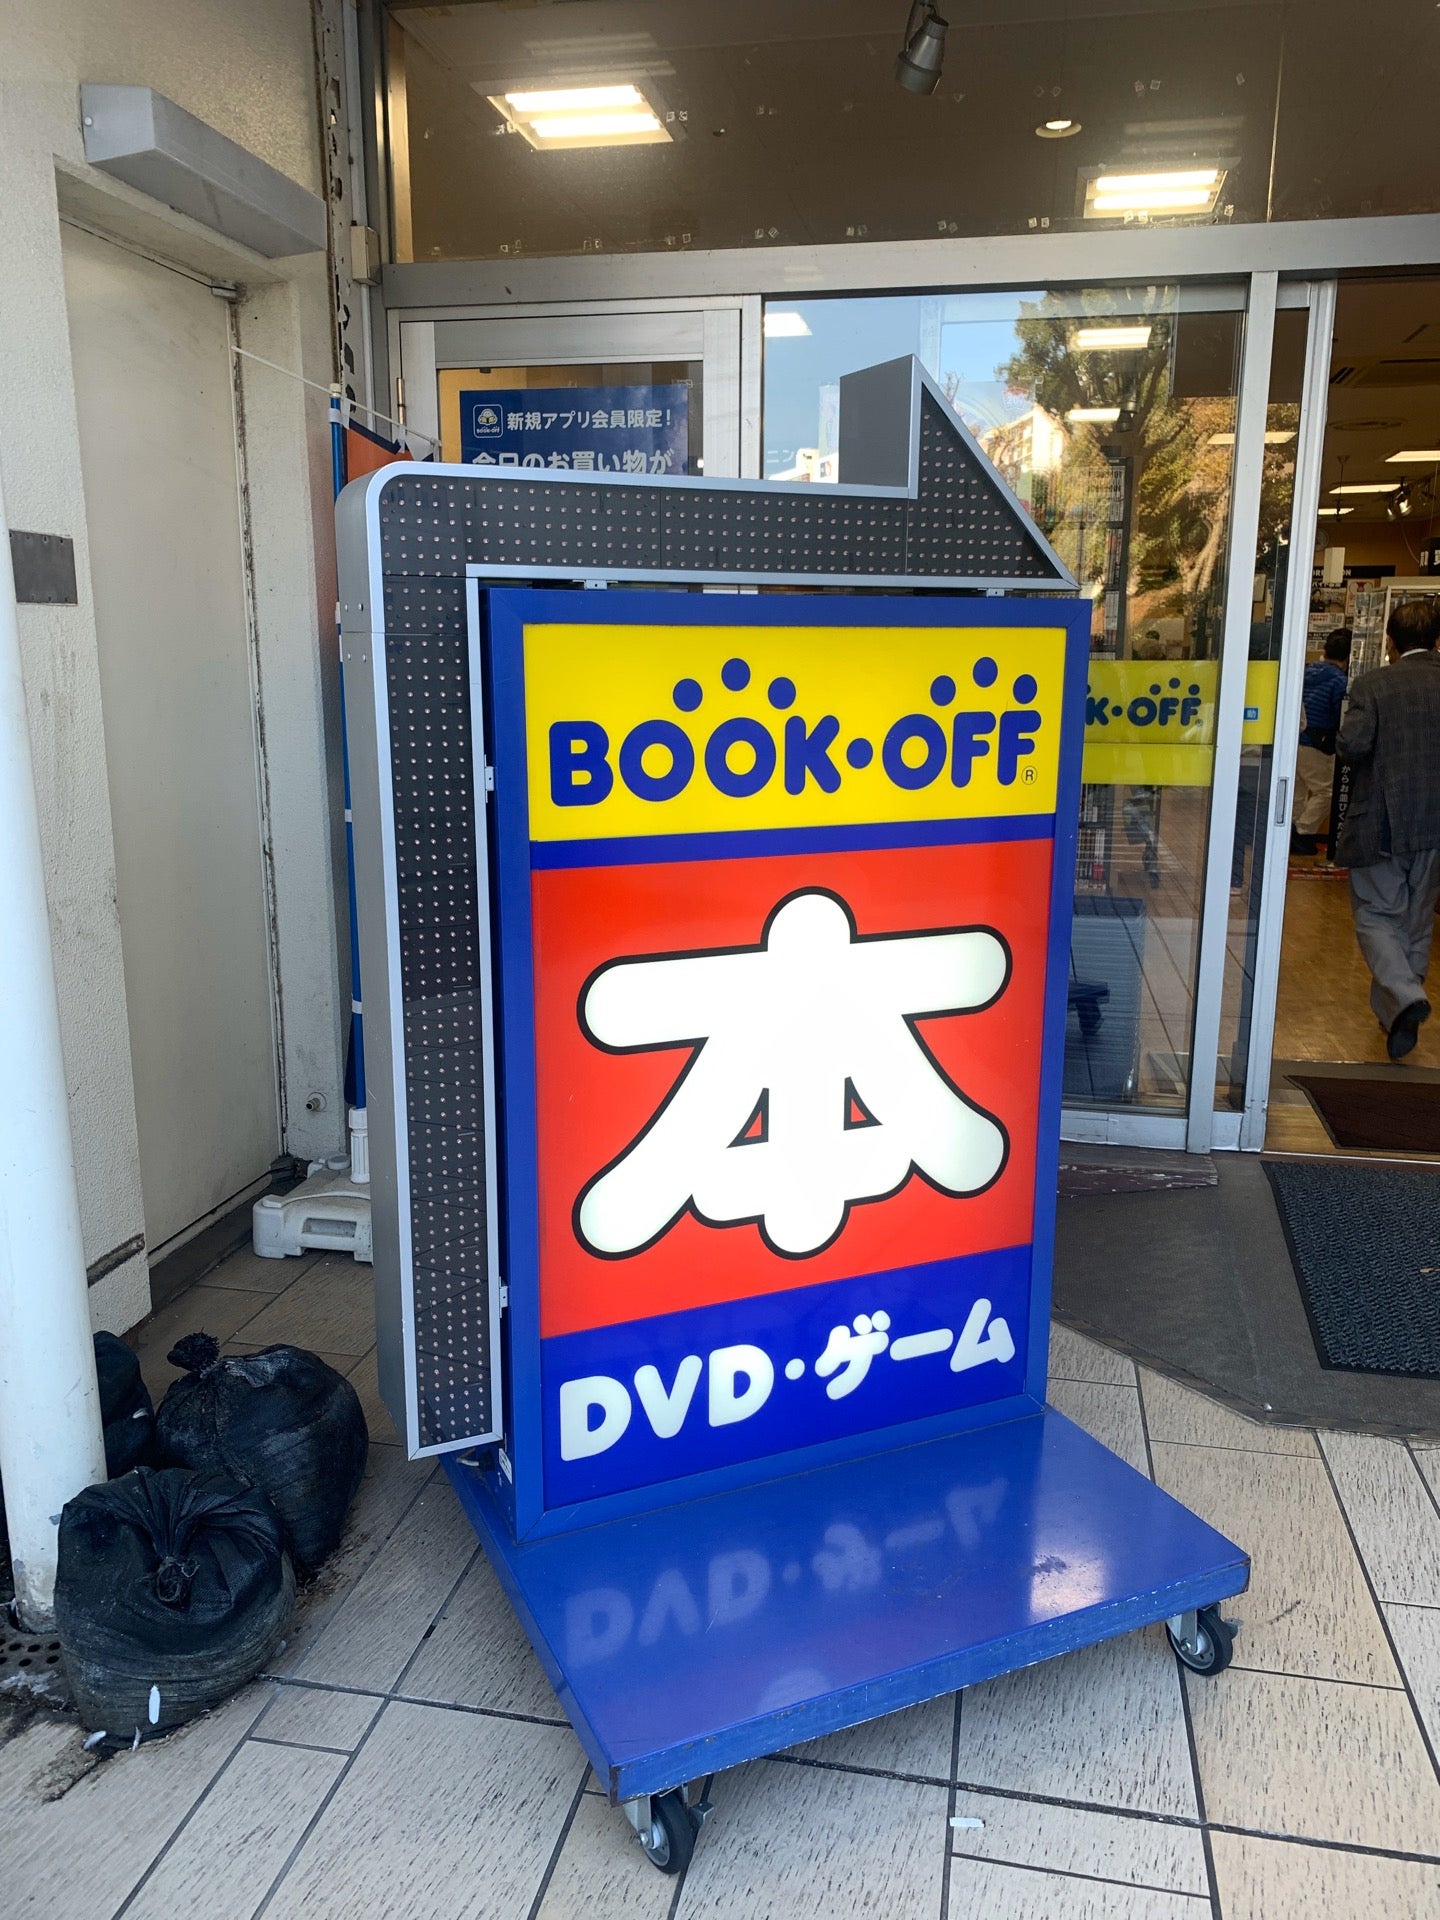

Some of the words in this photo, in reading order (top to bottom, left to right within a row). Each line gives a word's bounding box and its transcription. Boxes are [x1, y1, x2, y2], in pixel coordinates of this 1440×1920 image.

[507, 408, 672, 431] 新規アプリ会員限定！
[578, 888, 1009, 1256] 本
[559, 1298, 1016, 1462] DVD・ゲーム
